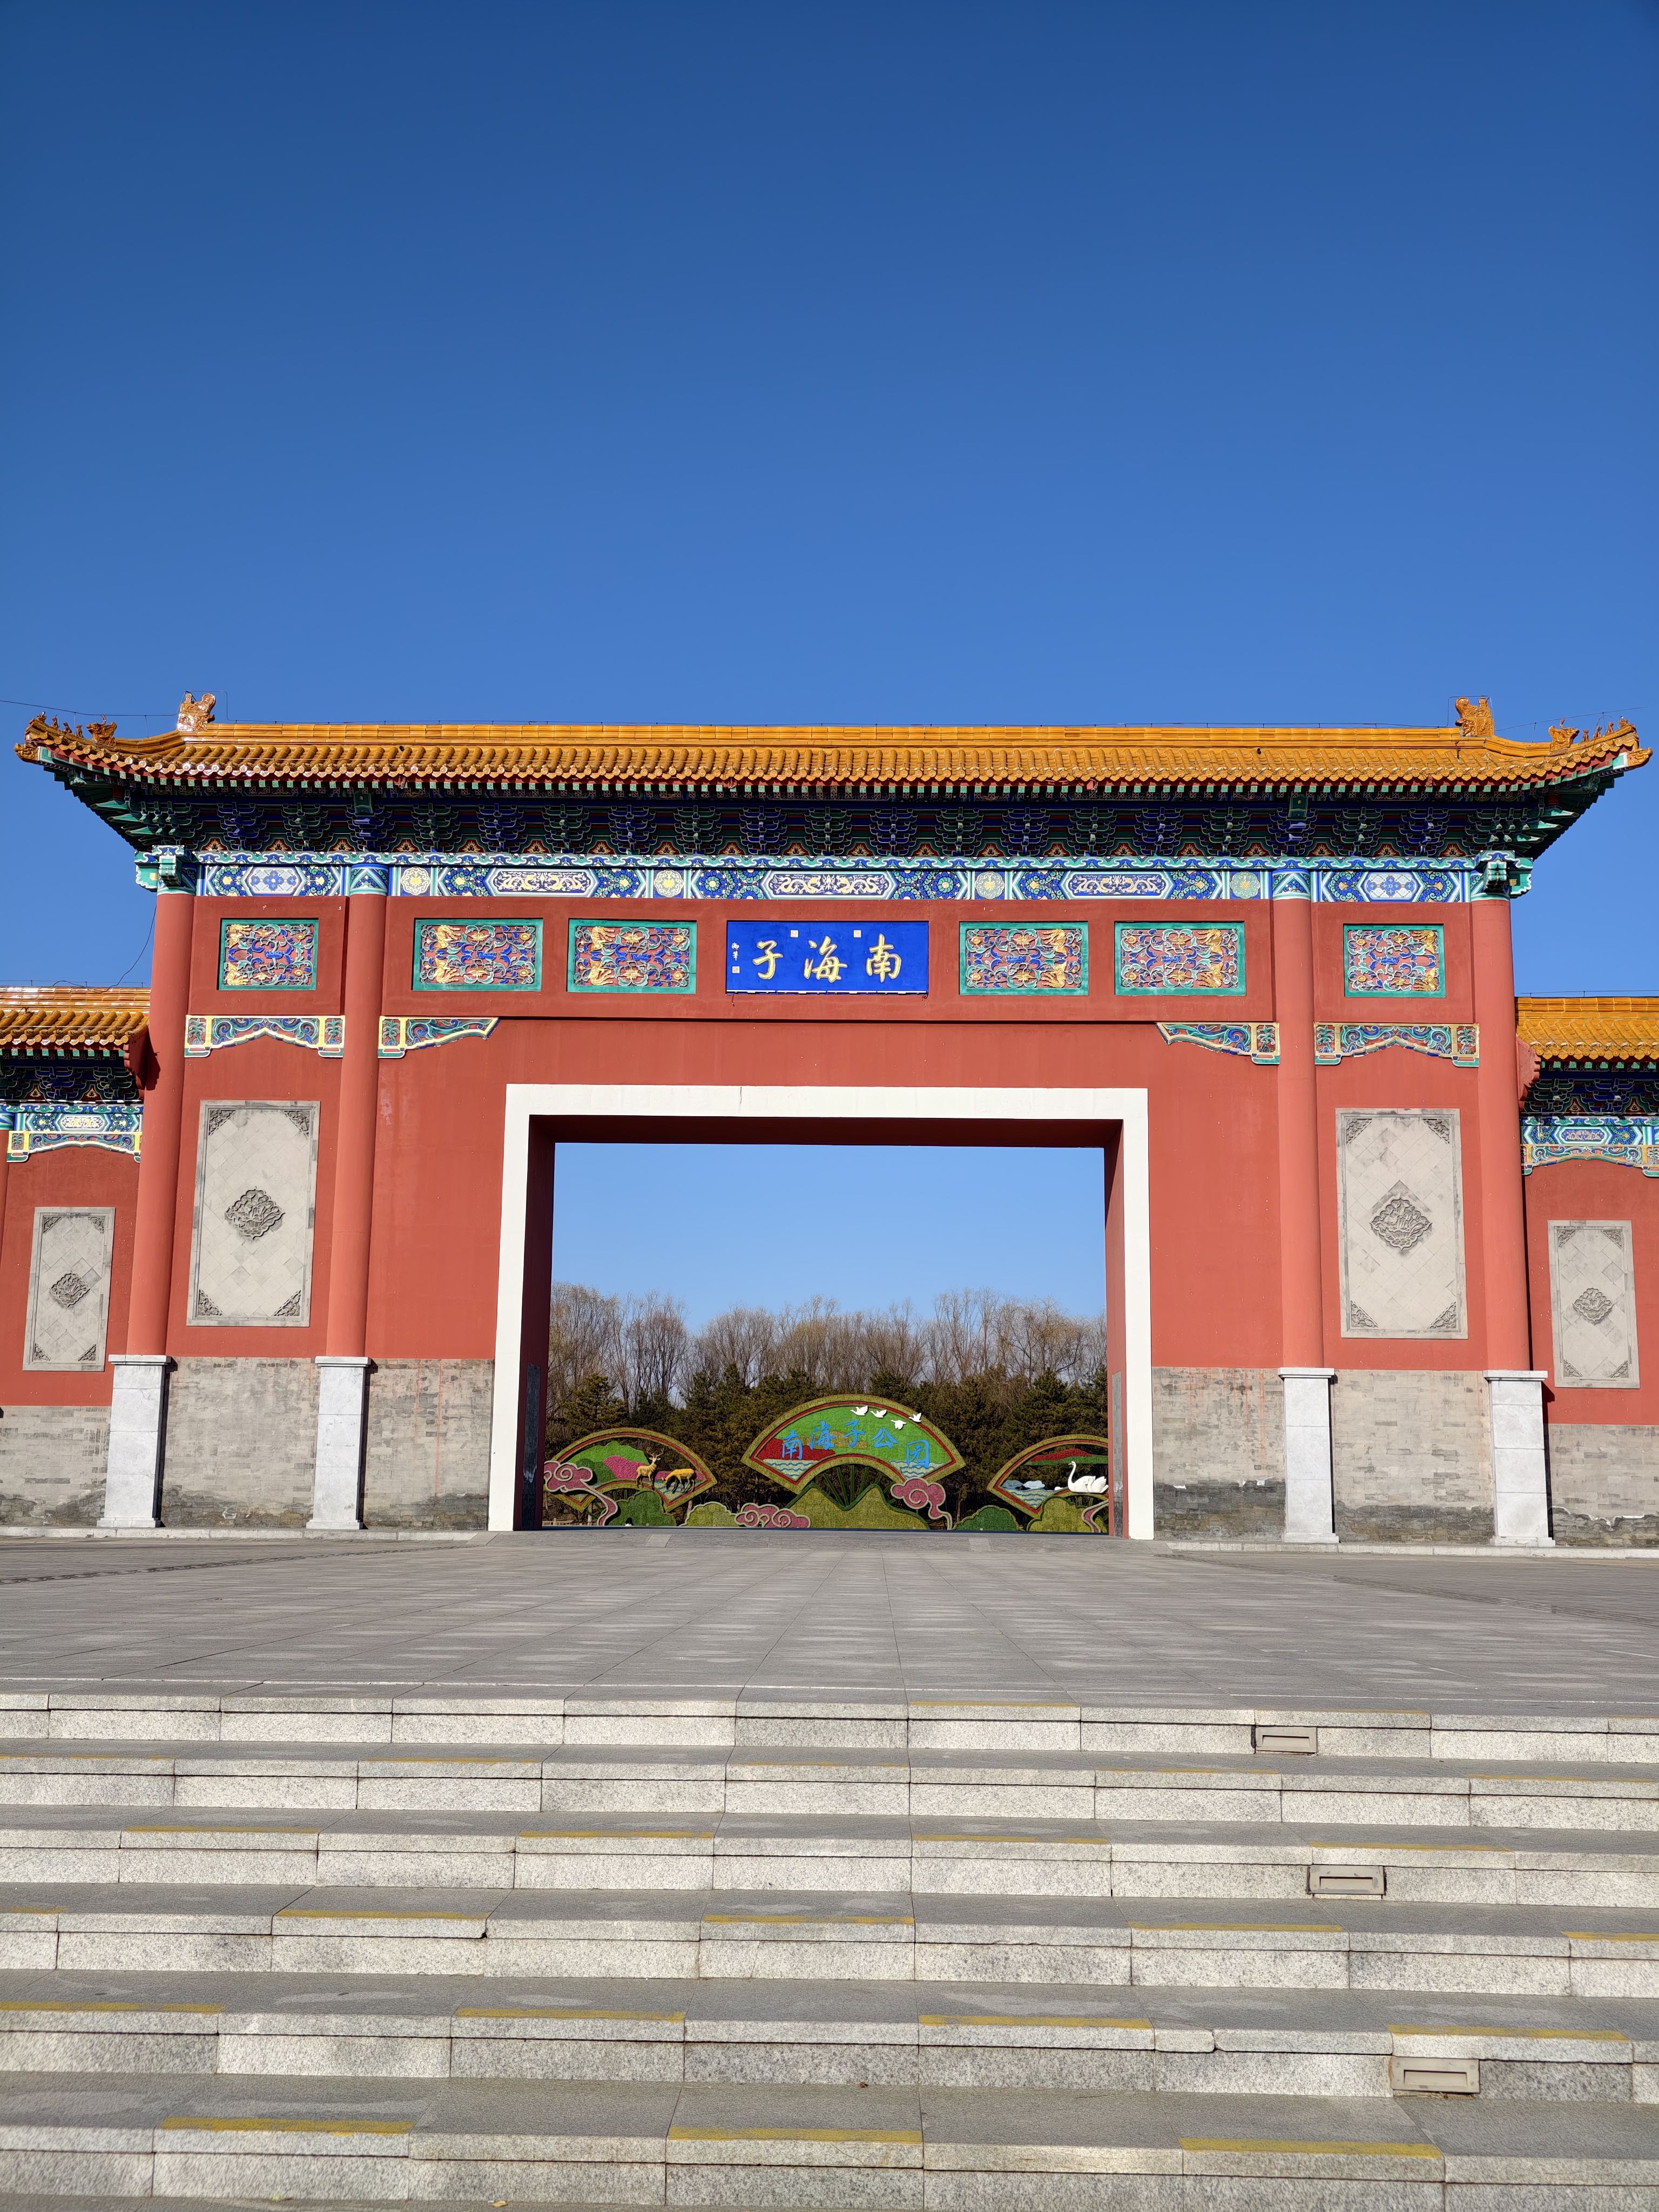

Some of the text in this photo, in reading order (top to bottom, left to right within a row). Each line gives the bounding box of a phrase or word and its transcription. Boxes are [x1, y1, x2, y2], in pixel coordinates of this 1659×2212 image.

[752, 933, 902, 983] 南海子
[781, 1420, 929, 1468] 南海子公园
